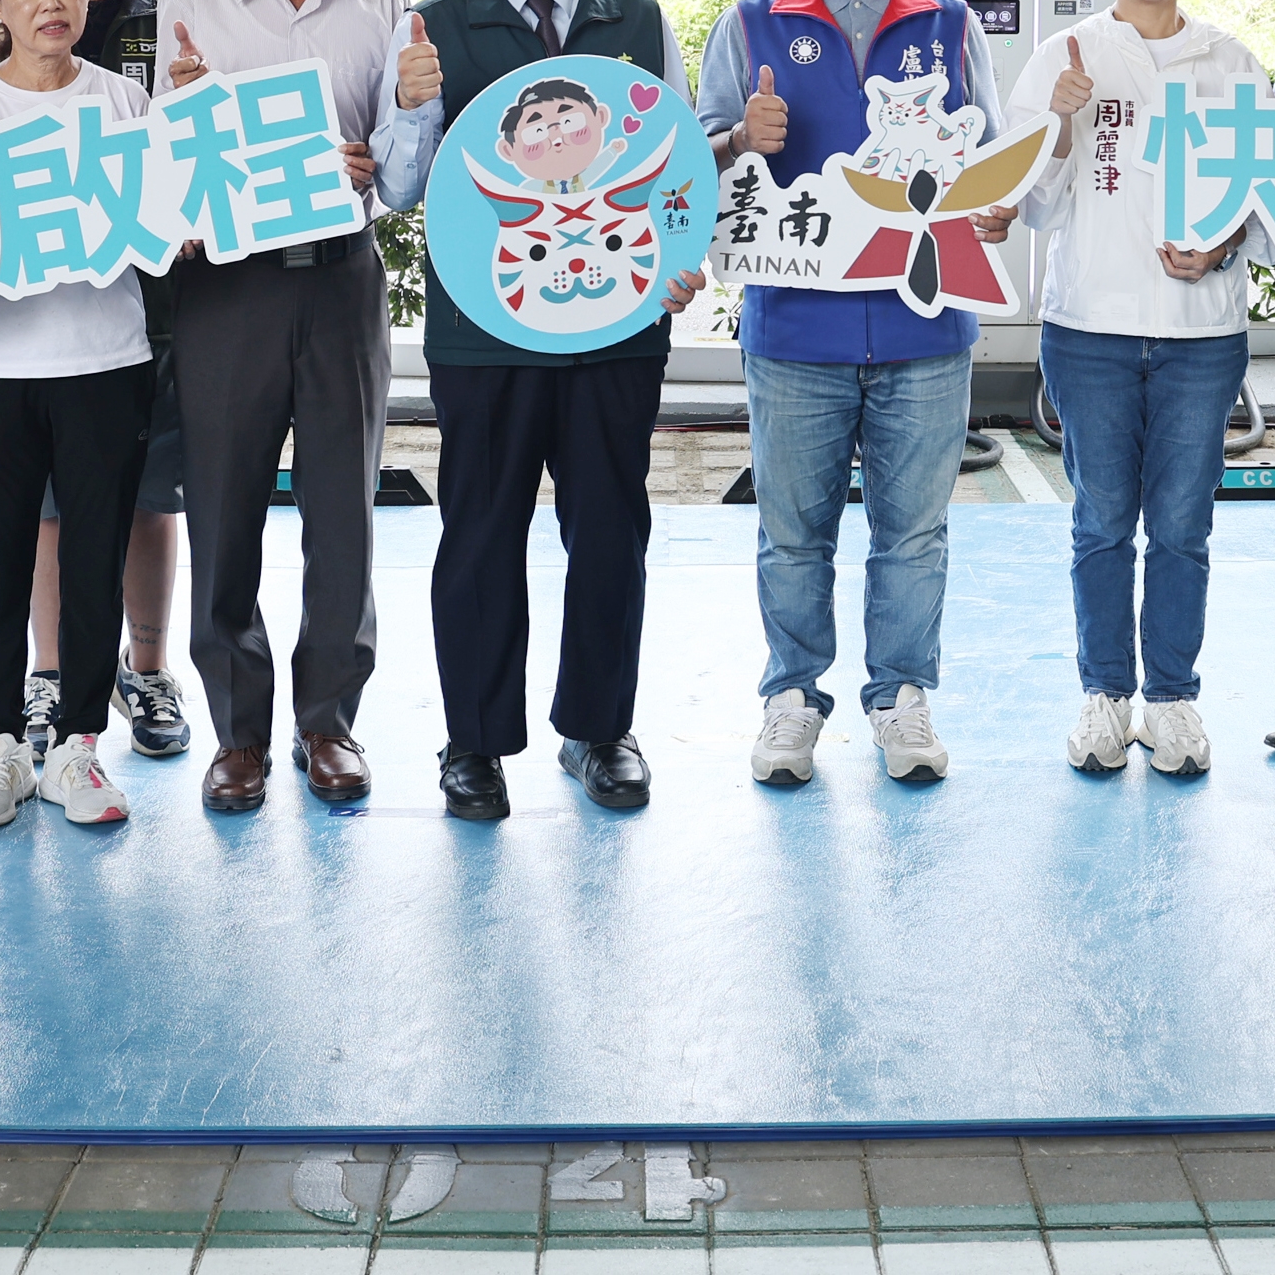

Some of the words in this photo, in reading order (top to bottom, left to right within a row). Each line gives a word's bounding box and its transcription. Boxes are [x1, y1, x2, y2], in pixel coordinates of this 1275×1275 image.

[1094, 99, 1122, 196] 周麗津
[719, 252, 821, 278] TAINAN
